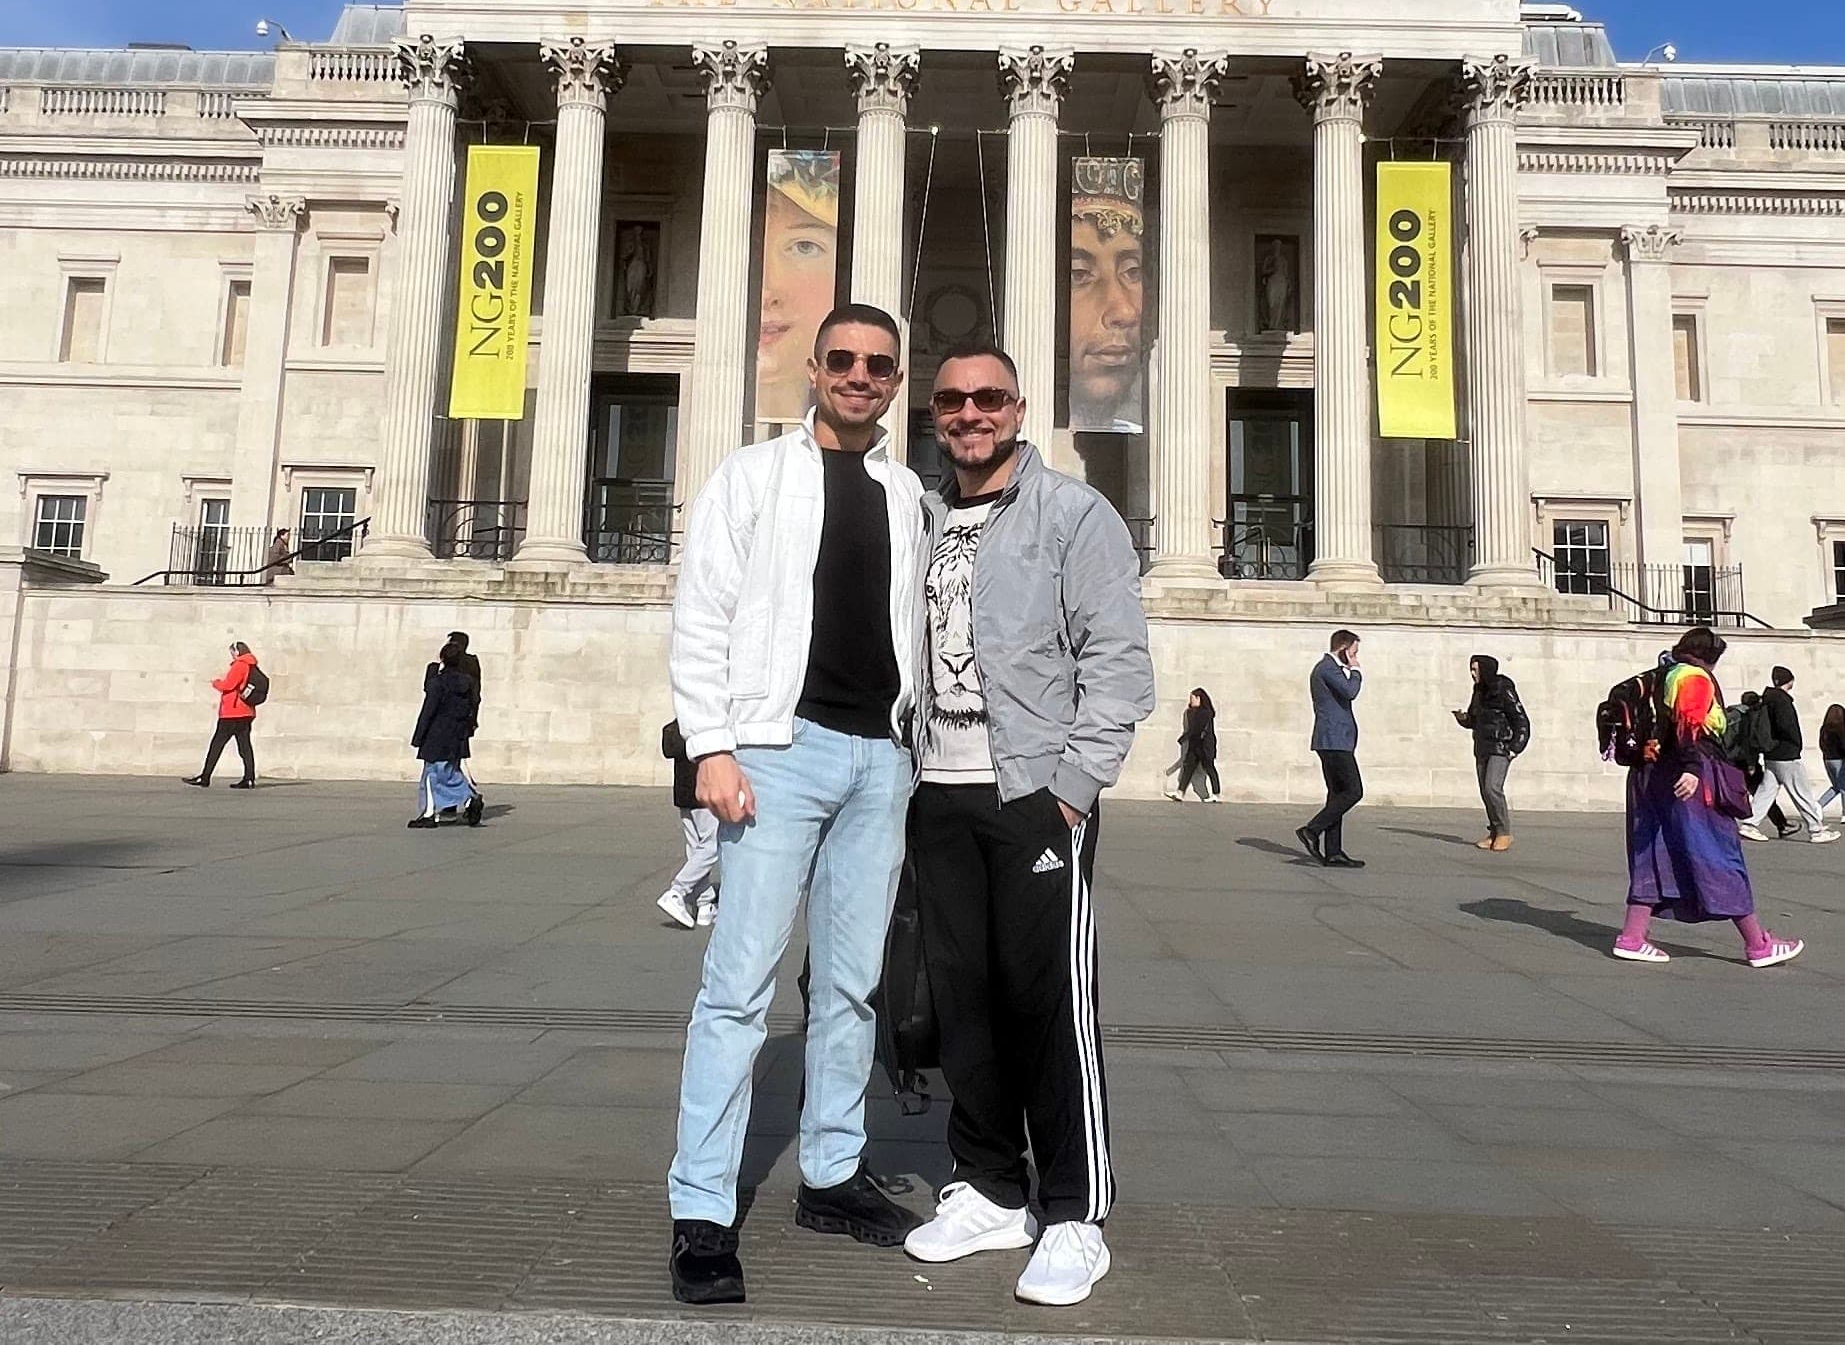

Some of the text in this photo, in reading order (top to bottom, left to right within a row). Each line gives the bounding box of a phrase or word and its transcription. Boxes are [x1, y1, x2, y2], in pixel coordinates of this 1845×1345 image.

[468, 190, 508, 359] NG200
[505, 191, 524, 360] 200 YEARS OF THE NATIONAL GALLERY
[1388, 209, 1423, 379] NG200
[1427, 209, 1438, 380] 200 YEARS OF THE NATIONAL GALLERY
